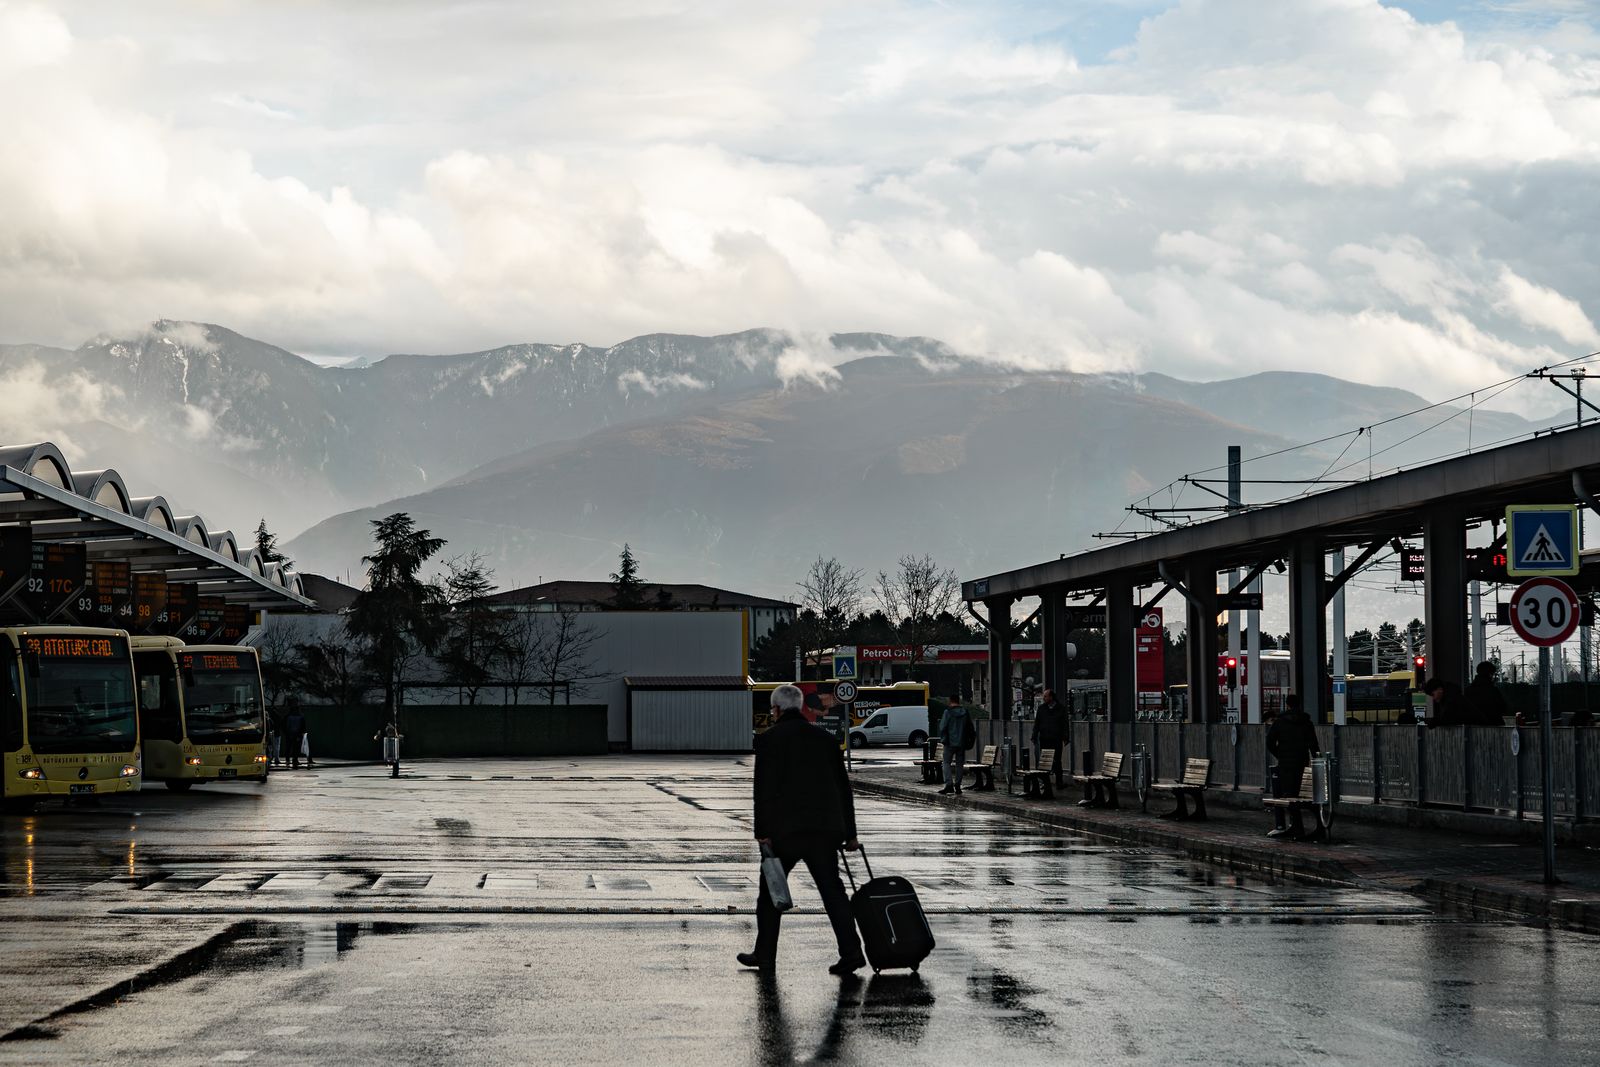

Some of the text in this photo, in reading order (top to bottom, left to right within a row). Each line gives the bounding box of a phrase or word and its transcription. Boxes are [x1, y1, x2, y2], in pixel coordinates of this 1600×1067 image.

[28, 578, 73, 593] 92 17C
[78, 598, 92, 611] 93
[120, 604, 151, 617] 94 98
[1524, 597, 1565, 628] 30
[187, 625, 198, 636] 96
[863, 648, 892, 658] Petrol
[838, 686, 853, 697] 30
